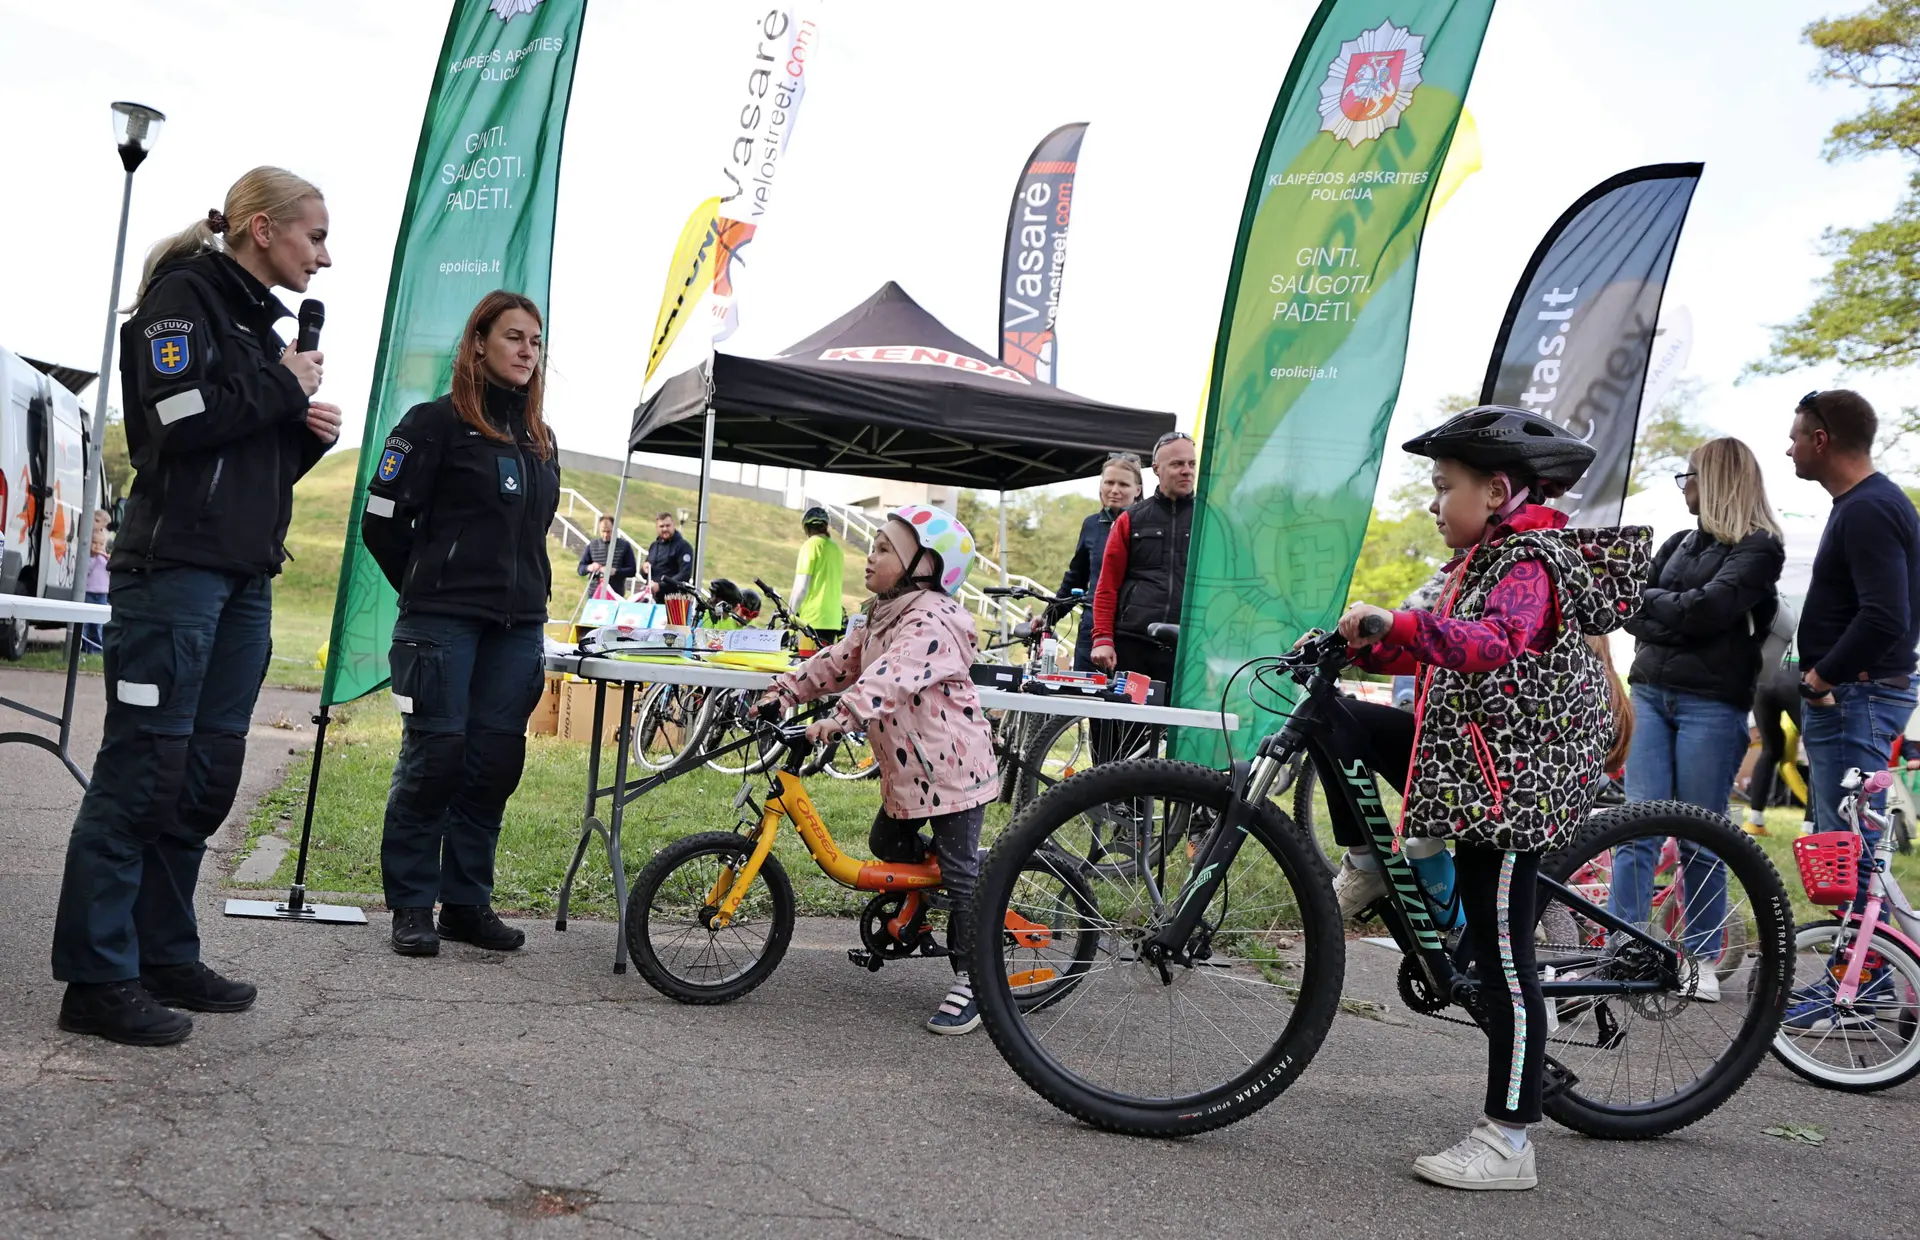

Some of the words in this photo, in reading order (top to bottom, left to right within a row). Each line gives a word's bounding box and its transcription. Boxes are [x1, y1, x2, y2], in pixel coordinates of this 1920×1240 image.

[720, 9, 789, 204] Vasarė
[465, 125, 507, 154] GINTI.
[441, 156, 526, 185] SAUGOTI.
[1268, 170, 1344, 186] KLAIPĖDOS
[1347, 170, 1429, 186] APSKRITIES
[444, 184, 513, 213] PADĖTI.
[1311, 187, 1373, 201] POLICIJA
[439, 259, 501, 275] epolicija.lt
[1004, 182, 1052, 329] Vasarė
[1044, 182, 1072, 330] velostreet.com
[1296, 246, 1361, 268] GINTI.
[1269, 273, 1372, 295] SAUGOTI.
[1272, 299, 1357, 322] PADĖTI.
[147, 321, 189, 335] LIETUVA
[827, 348, 1022, 380] KENDA
[1520, 286, 1580, 420] tas.lt
[1270, 365, 1338, 380] epolicija.lt
[387, 439, 411, 451] LIETUVA
[796, 797, 838, 864] ORBEA
[1338, 758, 1443, 950] SPECIALIZED
